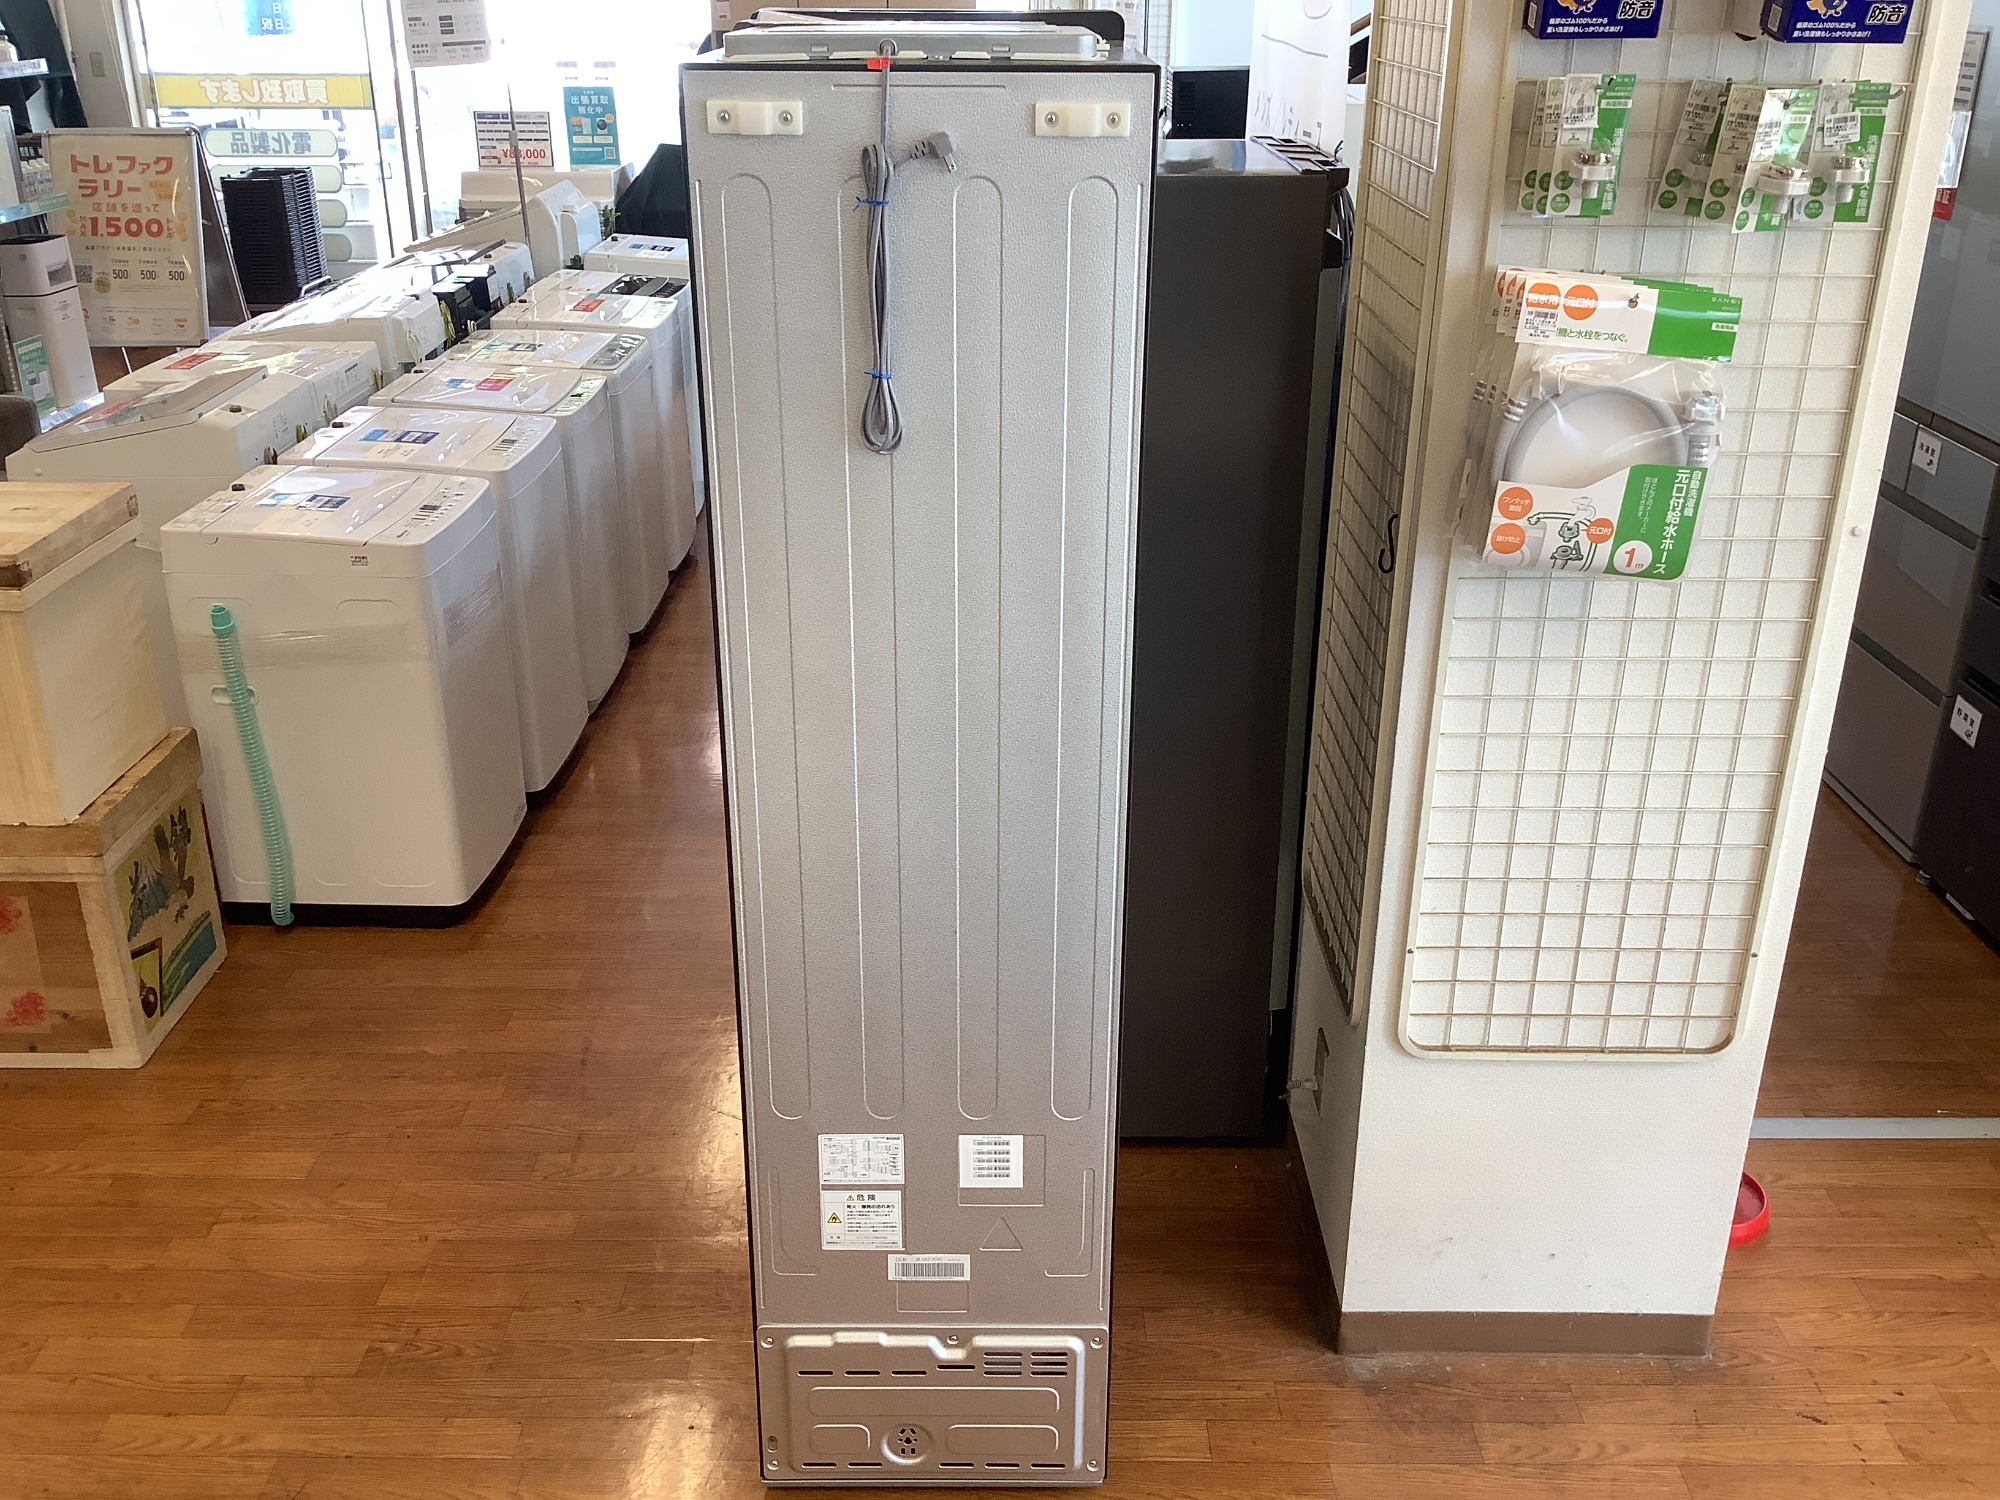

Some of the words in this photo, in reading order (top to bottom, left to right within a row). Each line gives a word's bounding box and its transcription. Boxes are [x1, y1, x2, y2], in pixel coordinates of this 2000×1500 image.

[1617, 0, 1655, 19] 防音
[1865, 4, 1906, 25] 防音
[571, 95, 609, 105] 出張買取
[70, 154, 173, 175] トレファク
[78, 178, 141, 198] ラリー
[92, 202, 160, 213] 店舗を巡って
[89, 216, 164, 238] 1,500
[112, 268, 129, 280] 500
[140, 269, 157, 281] 500
[168, 270, 185, 281] 500
[1557, 327, 1629, 342] 機と水栓をつなぐ。
[1652, 469, 1691, 575] 元口付給水ホース
[1588, 526, 1612, 535] 元口付
[856, 1193, 876, 1201] 危険
